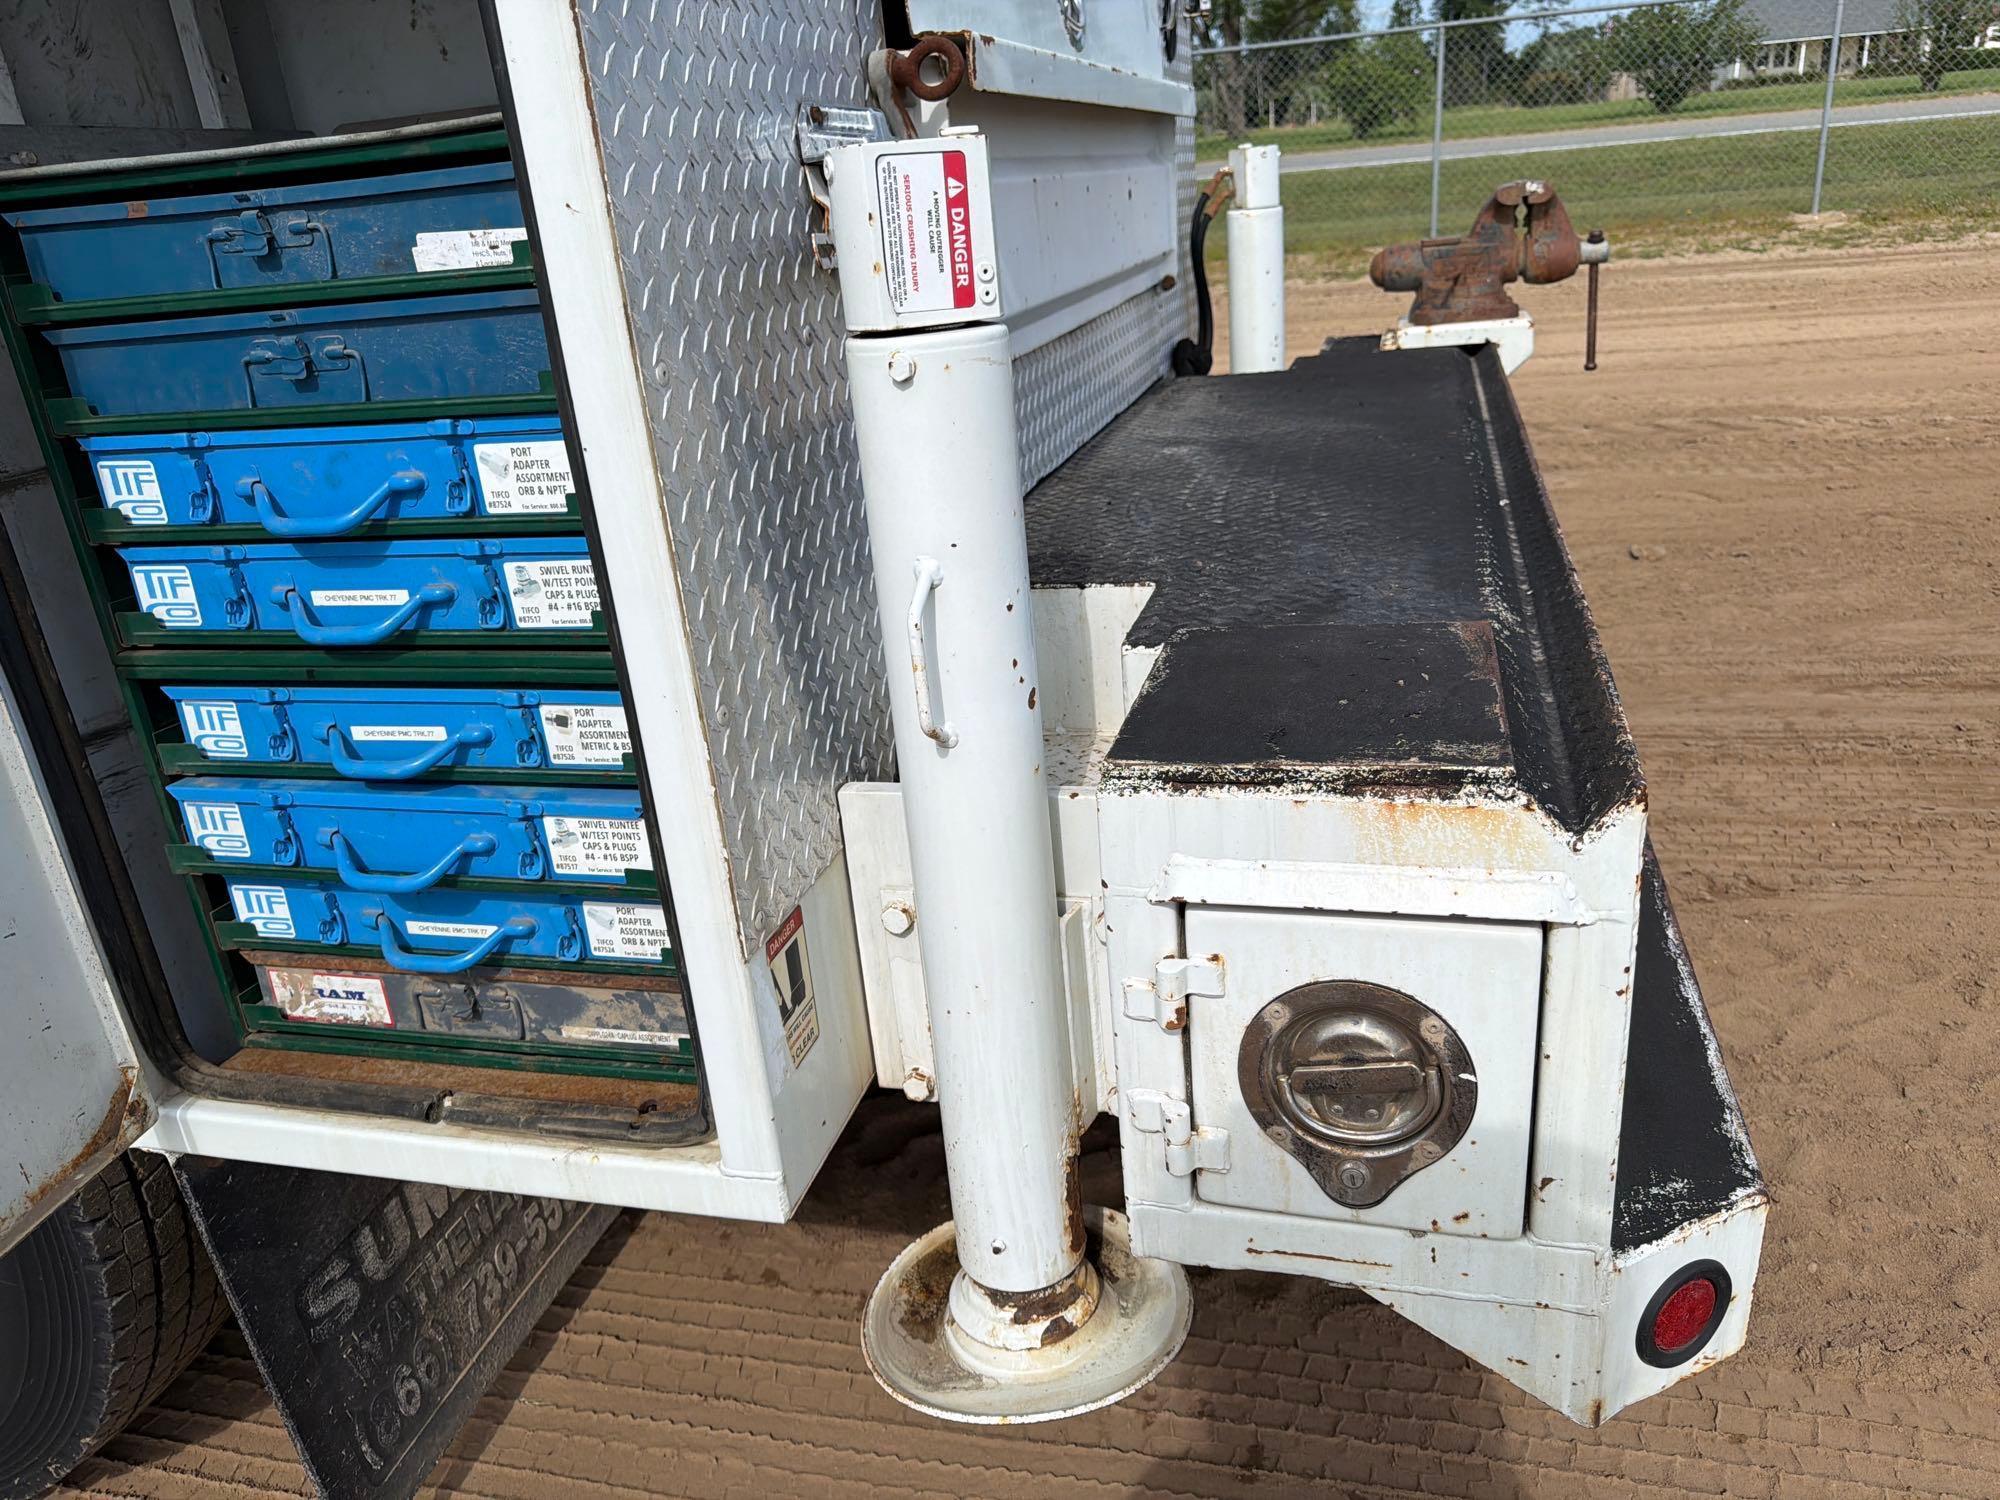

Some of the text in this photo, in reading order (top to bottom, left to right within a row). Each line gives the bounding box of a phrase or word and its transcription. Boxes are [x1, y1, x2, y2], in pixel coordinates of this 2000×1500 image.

[903, 174, 919, 292] SERIOUS CRUSHING INJURY
[936, 230, 944, 273] OUTRIGGER
[951, 208, 969, 288] DANGER
[510, 447, 531, 457] PORT
[513, 460, 550, 470] ADAPTER
[516, 472, 570, 482] ASSORTMENT
[491, 490, 510, 499] TIFCO
[518, 485, 567, 496] ORB & NPTF
[540, 565, 594, 576] SWIVEL RUNT
[542, 578, 596, 588] W/TEST POIN
[545, 590, 565, 599] CAPS
[567, 590, 574, 599] &
[521, 606, 540, 614] TIFCO
[548, 602, 559, 611] #4
[567, 602, 582, 611] #16
[574, 709, 594, 717] PORT
[577, 720, 612, 728] ADAPTER
[579, 731, 630, 739] ASSORTMENT
[582, 742, 632, 750] METRIC & BS
[578, 820, 640, 830] SWIVEL RUNTEE
[580, 831, 641, 840] W/TEST POINTS
[583, 842, 636, 851] CAPS & PLUGS
[585, 853, 595, 861] #4
[603, 853, 618, 861] #16
[620, 854, 639, 862] BSPP
[616, 907, 636, 916] PORT
[618, 918, 652, 926] ADAPTER
[418, 925, 451, 933] CHEYENNE
[620, 927, 669, 937] ASSORTMENT
[770, 919, 795, 955] DANGER
[621, 937, 666, 947] ORB & NPTF
[638, 1034, 671, 1042] ASSORTMENT
[796, 1027, 815, 1058] CLEAR
[456, 1198, 578, 1337] 739-55
